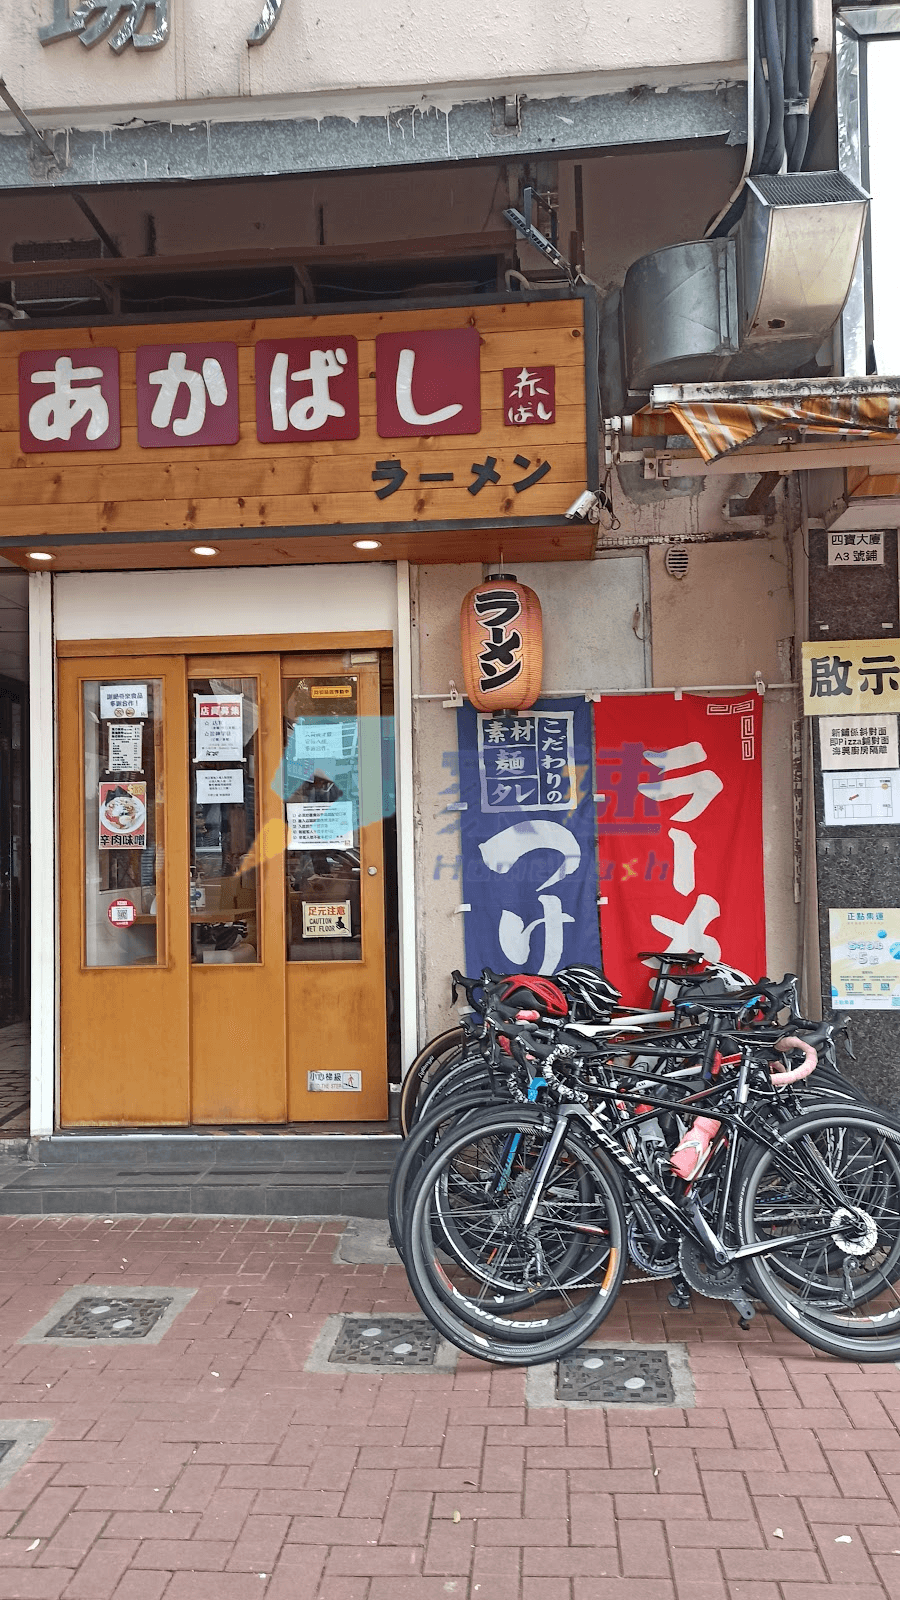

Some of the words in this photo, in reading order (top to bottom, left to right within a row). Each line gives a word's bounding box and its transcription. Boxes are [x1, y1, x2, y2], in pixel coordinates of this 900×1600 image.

[508, 367, 550, 398] 赤
[28, 347, 464, 442] あかばし
[508, 401, 552, 424] ばし
[371, 454, 552, 501] ラーメン
[831, 534, 882, 546] 四寶大廈
[834, 552, 850, 562] A3
[474, 589, 524, 694] ラーメン
[484, 720, 534, 743] 素材
[541, 719, 566, 803] こだわりの
[491, 783, 536, 804] タレ
[100, 834, 145, 846] 辛肉味噌
[308, 906, 346, 916] 足元注意
[309, 917, 333, 925] CAUTION
